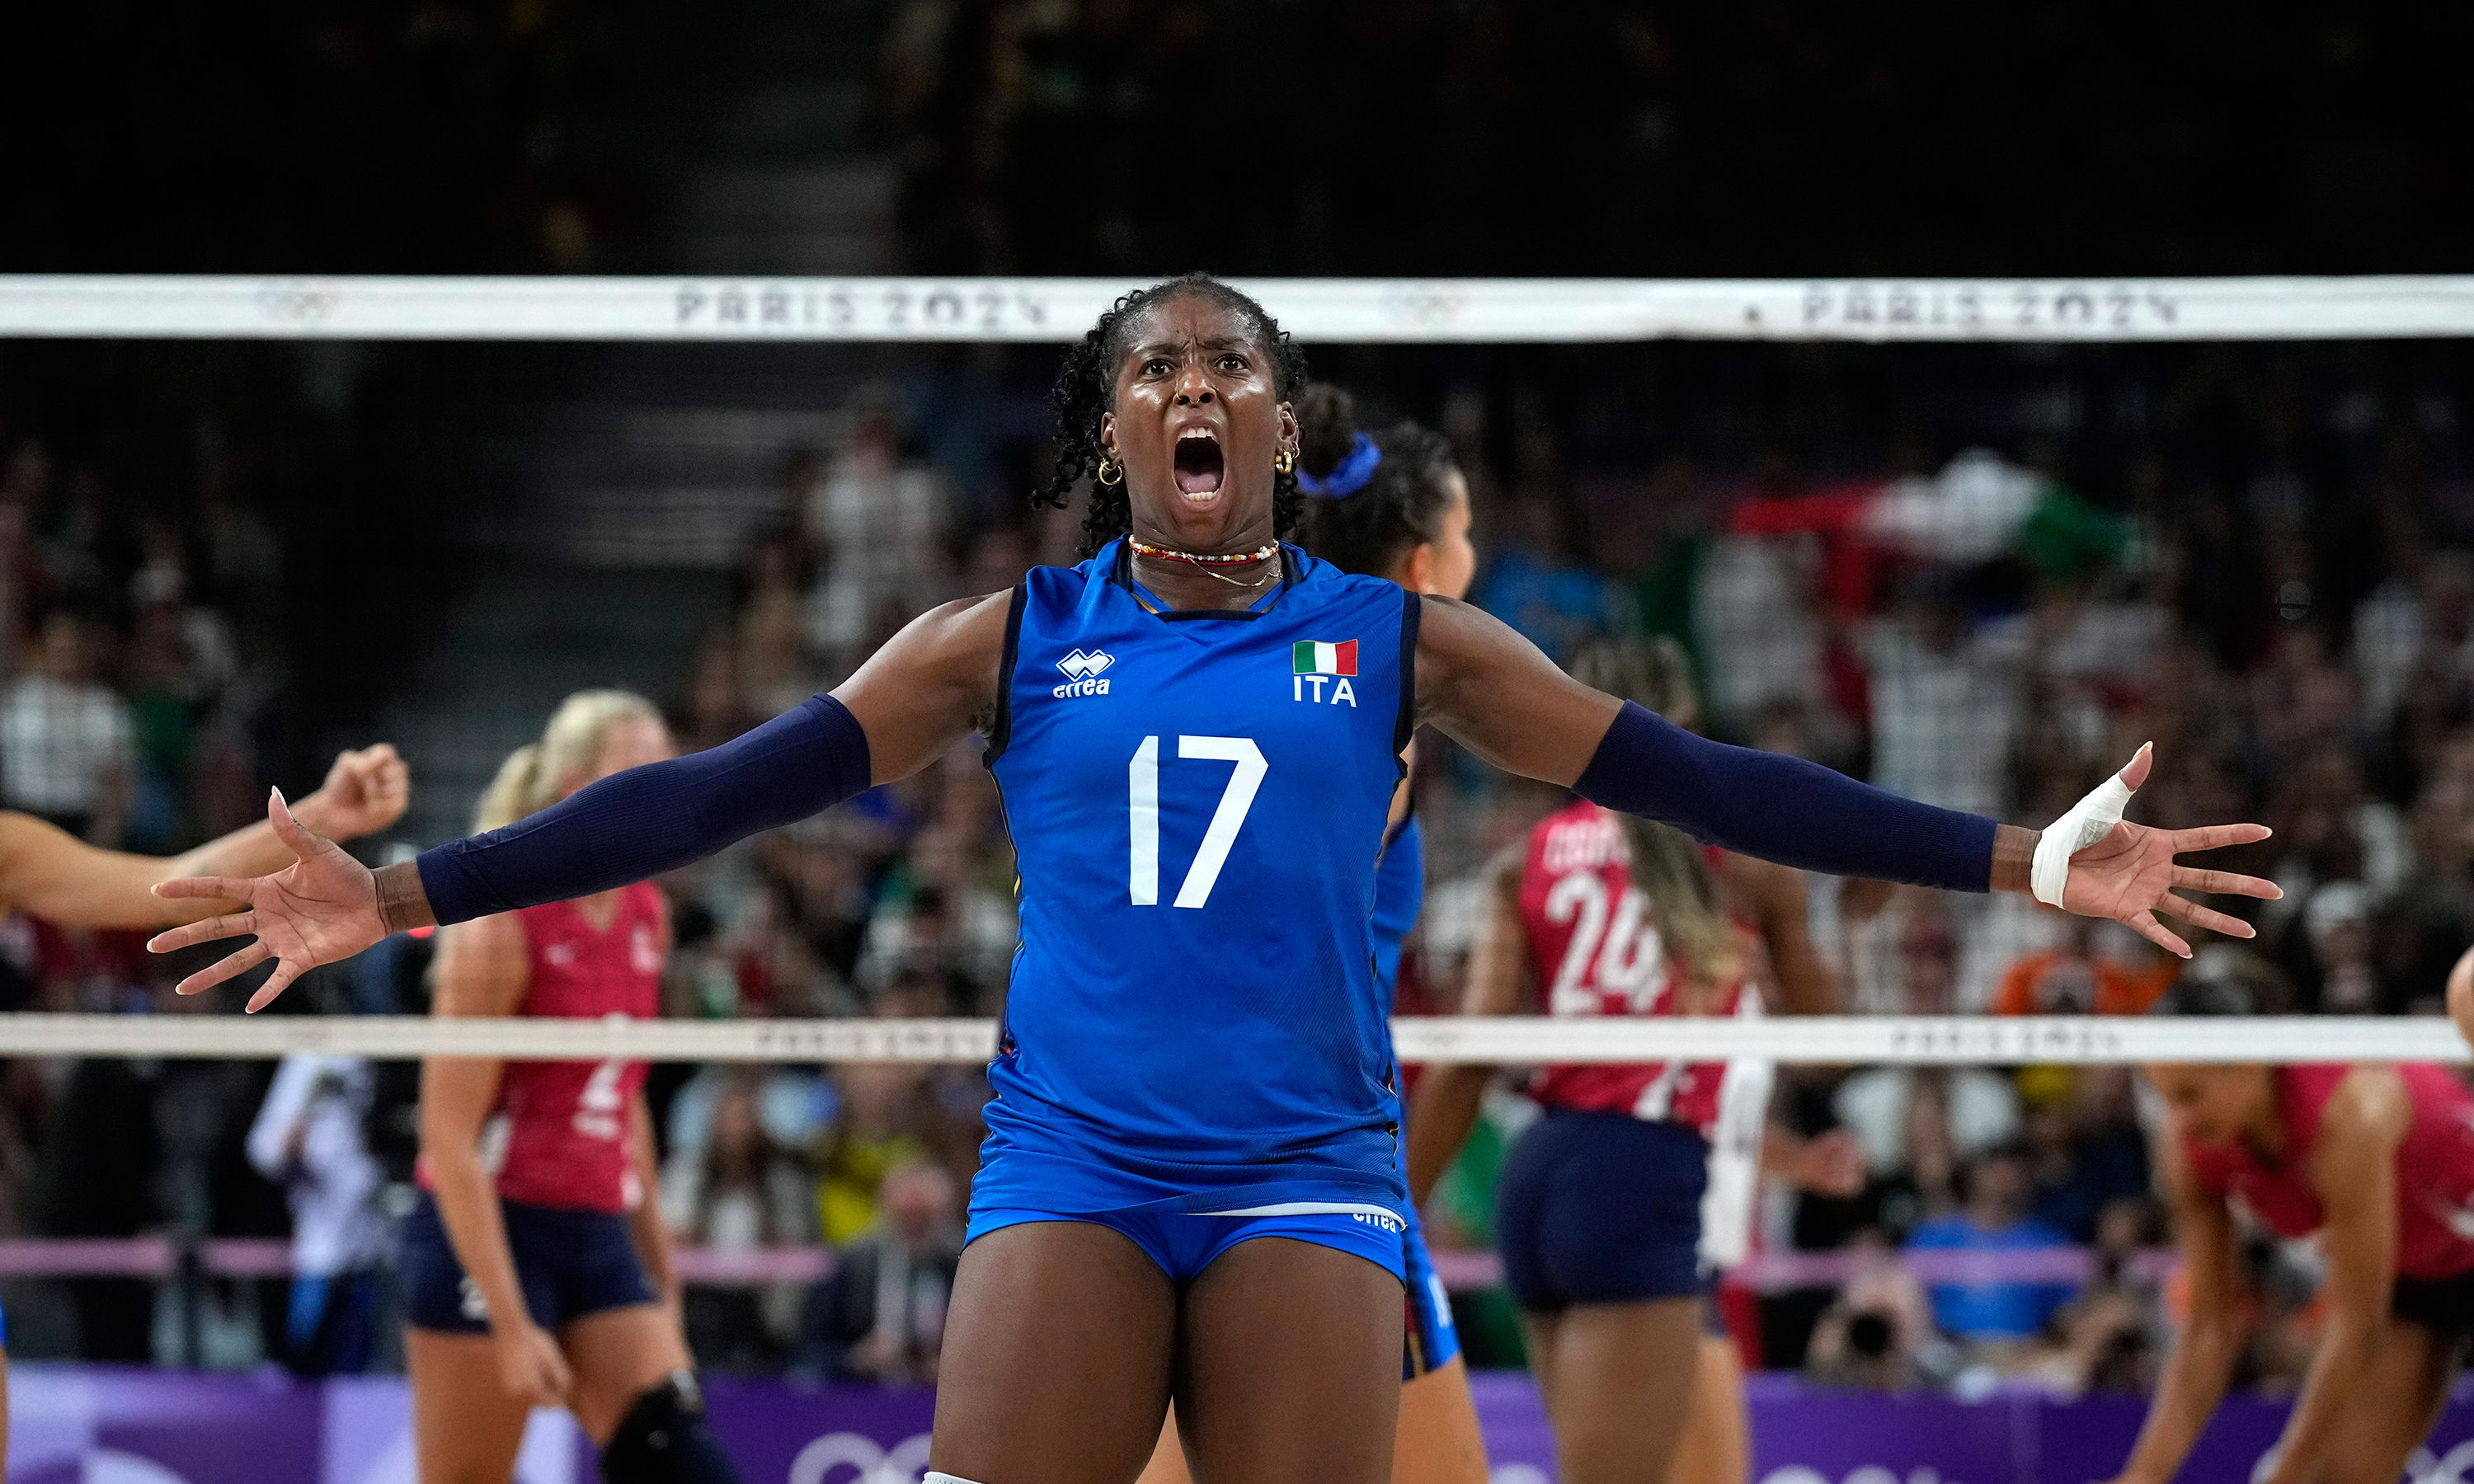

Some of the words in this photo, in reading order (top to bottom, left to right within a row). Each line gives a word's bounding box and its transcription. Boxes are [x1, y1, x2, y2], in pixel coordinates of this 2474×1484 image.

[675, 290, 854, 325] PARIS
[882, 290, 1047, 326] 2024
[1802, 292, 1978, 326] PARIS
[2012, 291, 2180, 326] 2024
[1293, 675, 1357, 707] ITA
[1129, 735, 1269, 909] 17
[1545, 871, 1669, 1017] 24
